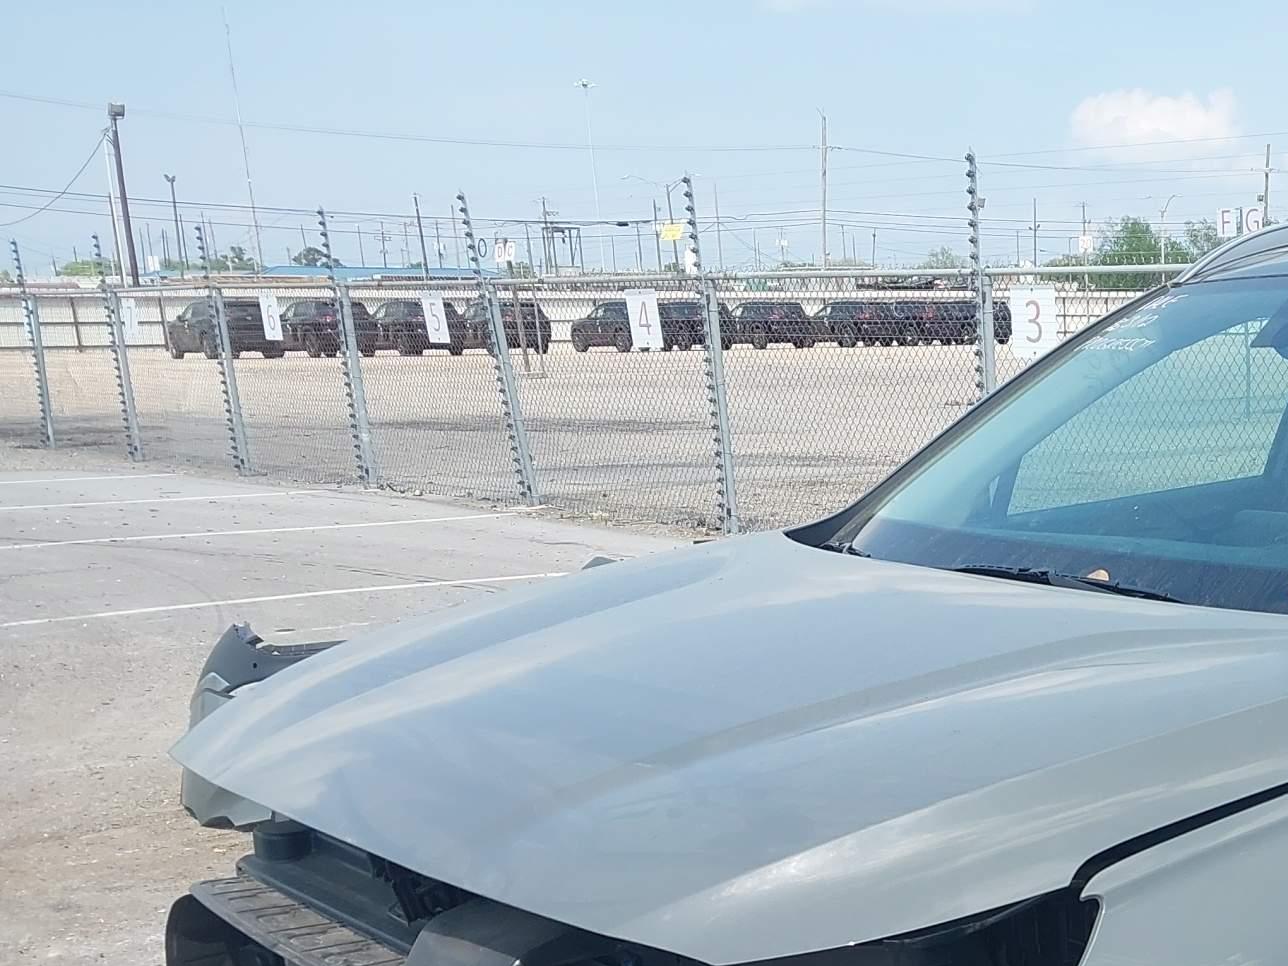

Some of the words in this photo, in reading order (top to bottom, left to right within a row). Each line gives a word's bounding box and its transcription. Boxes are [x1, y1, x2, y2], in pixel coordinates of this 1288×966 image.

[1222, 210, 1230, 235] F
[1246, 208, 1260, 232] G
[266, 305, 276, 330] 6
[427, 302, 442, 332] 5
[638, 301, 652, 335] 4
[1025, 300, 1043, 343] 3
